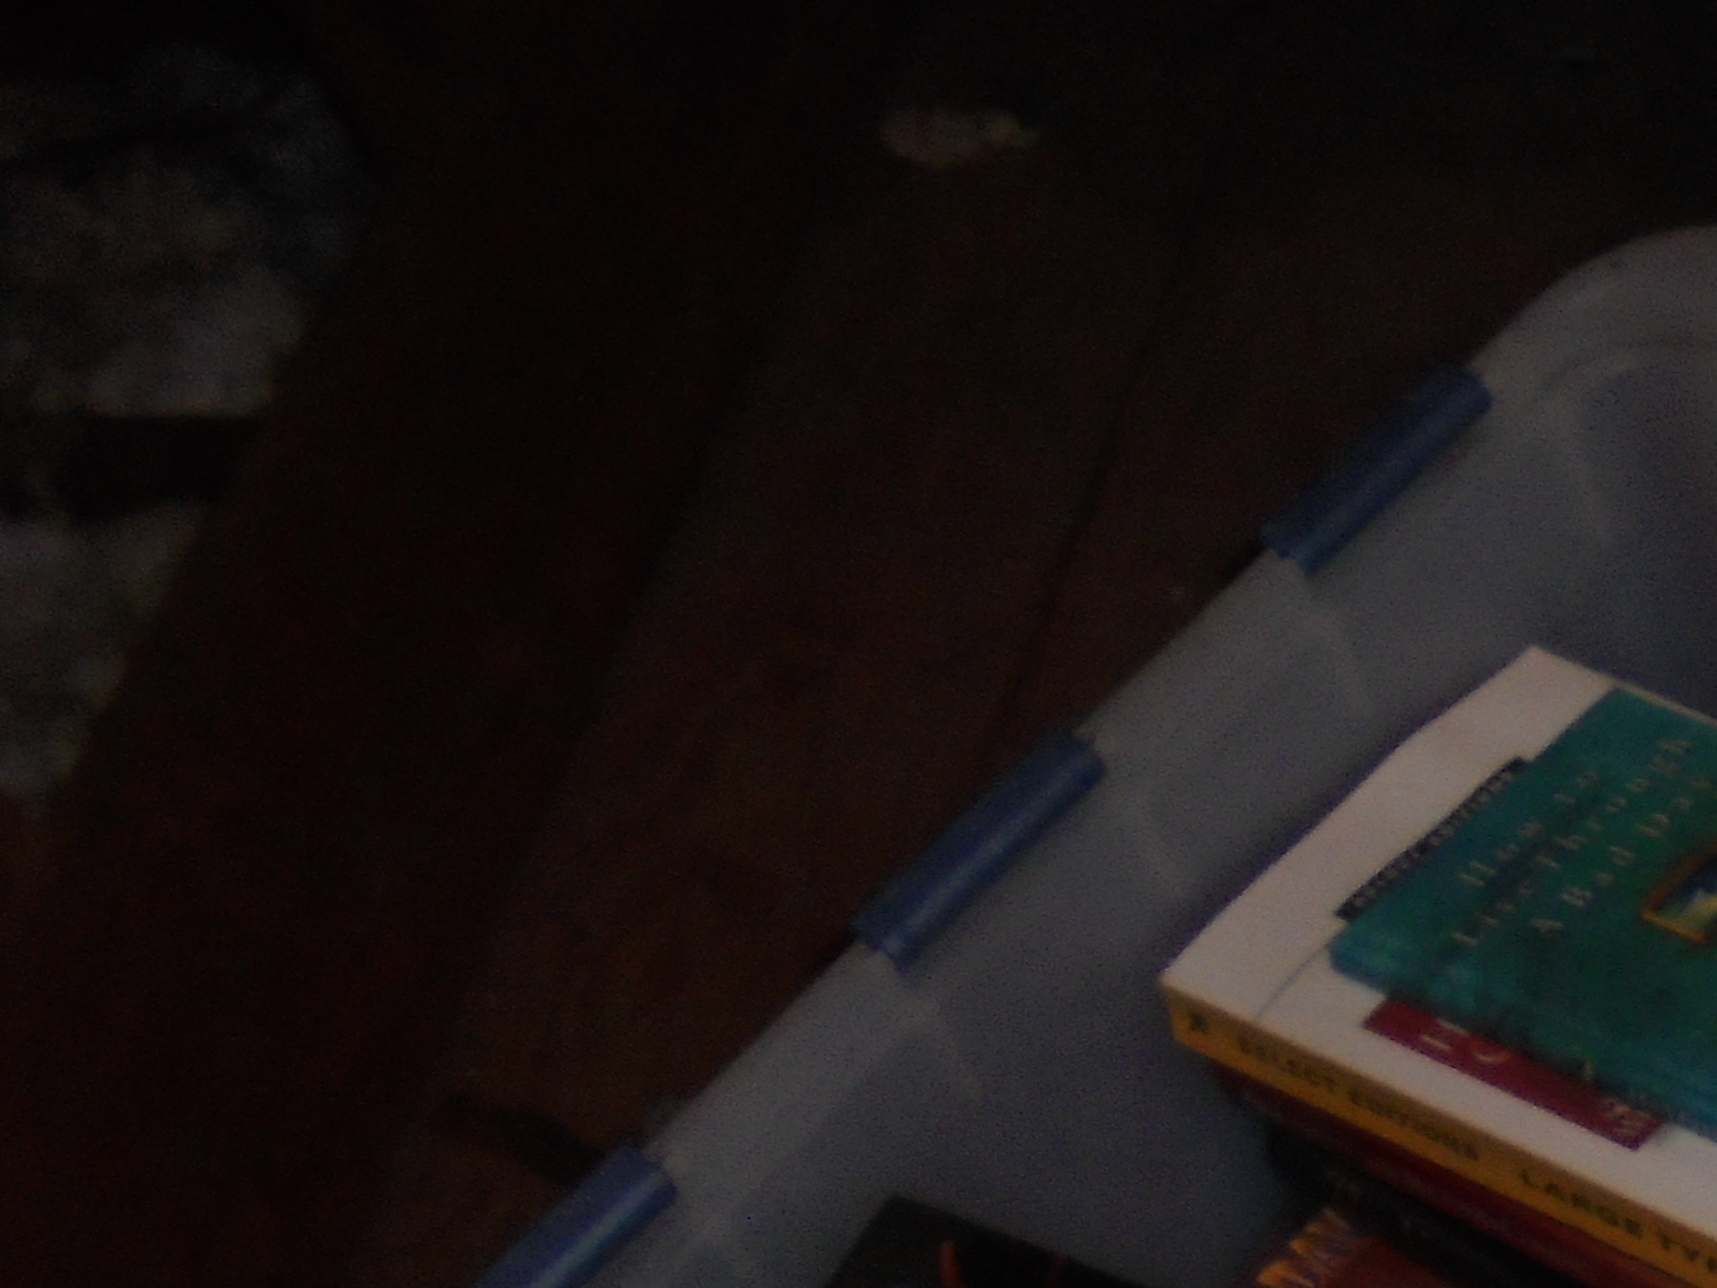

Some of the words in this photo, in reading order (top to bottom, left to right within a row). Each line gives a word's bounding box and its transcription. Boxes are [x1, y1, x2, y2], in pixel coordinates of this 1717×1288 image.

[1457, 820, 1545, 888] How
[1560, 844, 1640, 909] Bad
[1519, 1169, 1646, 1239] LARGE
